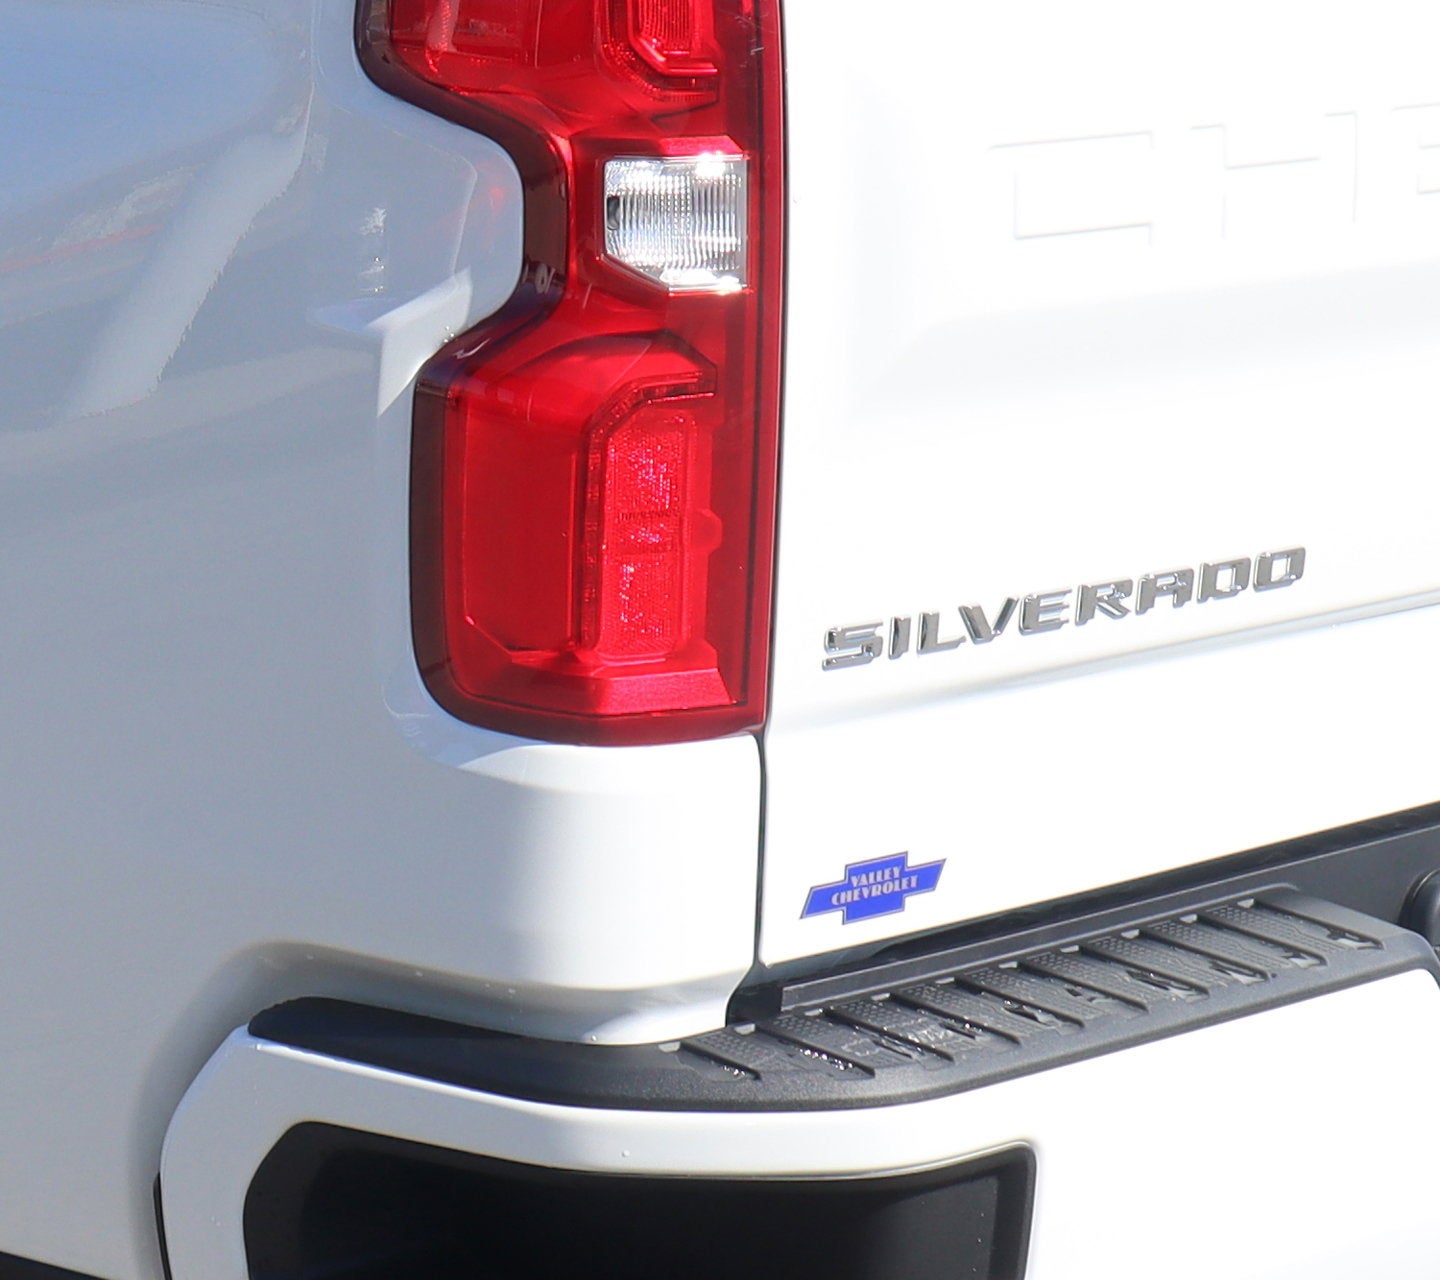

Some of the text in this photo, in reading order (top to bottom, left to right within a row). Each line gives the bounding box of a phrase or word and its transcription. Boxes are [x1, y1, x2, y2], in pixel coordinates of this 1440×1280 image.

[821, 546, 1307, 671] SILVERADO
[831, 875, 918, 906] CHEVROLET
[850, 866, 902, 888] VALLEY
